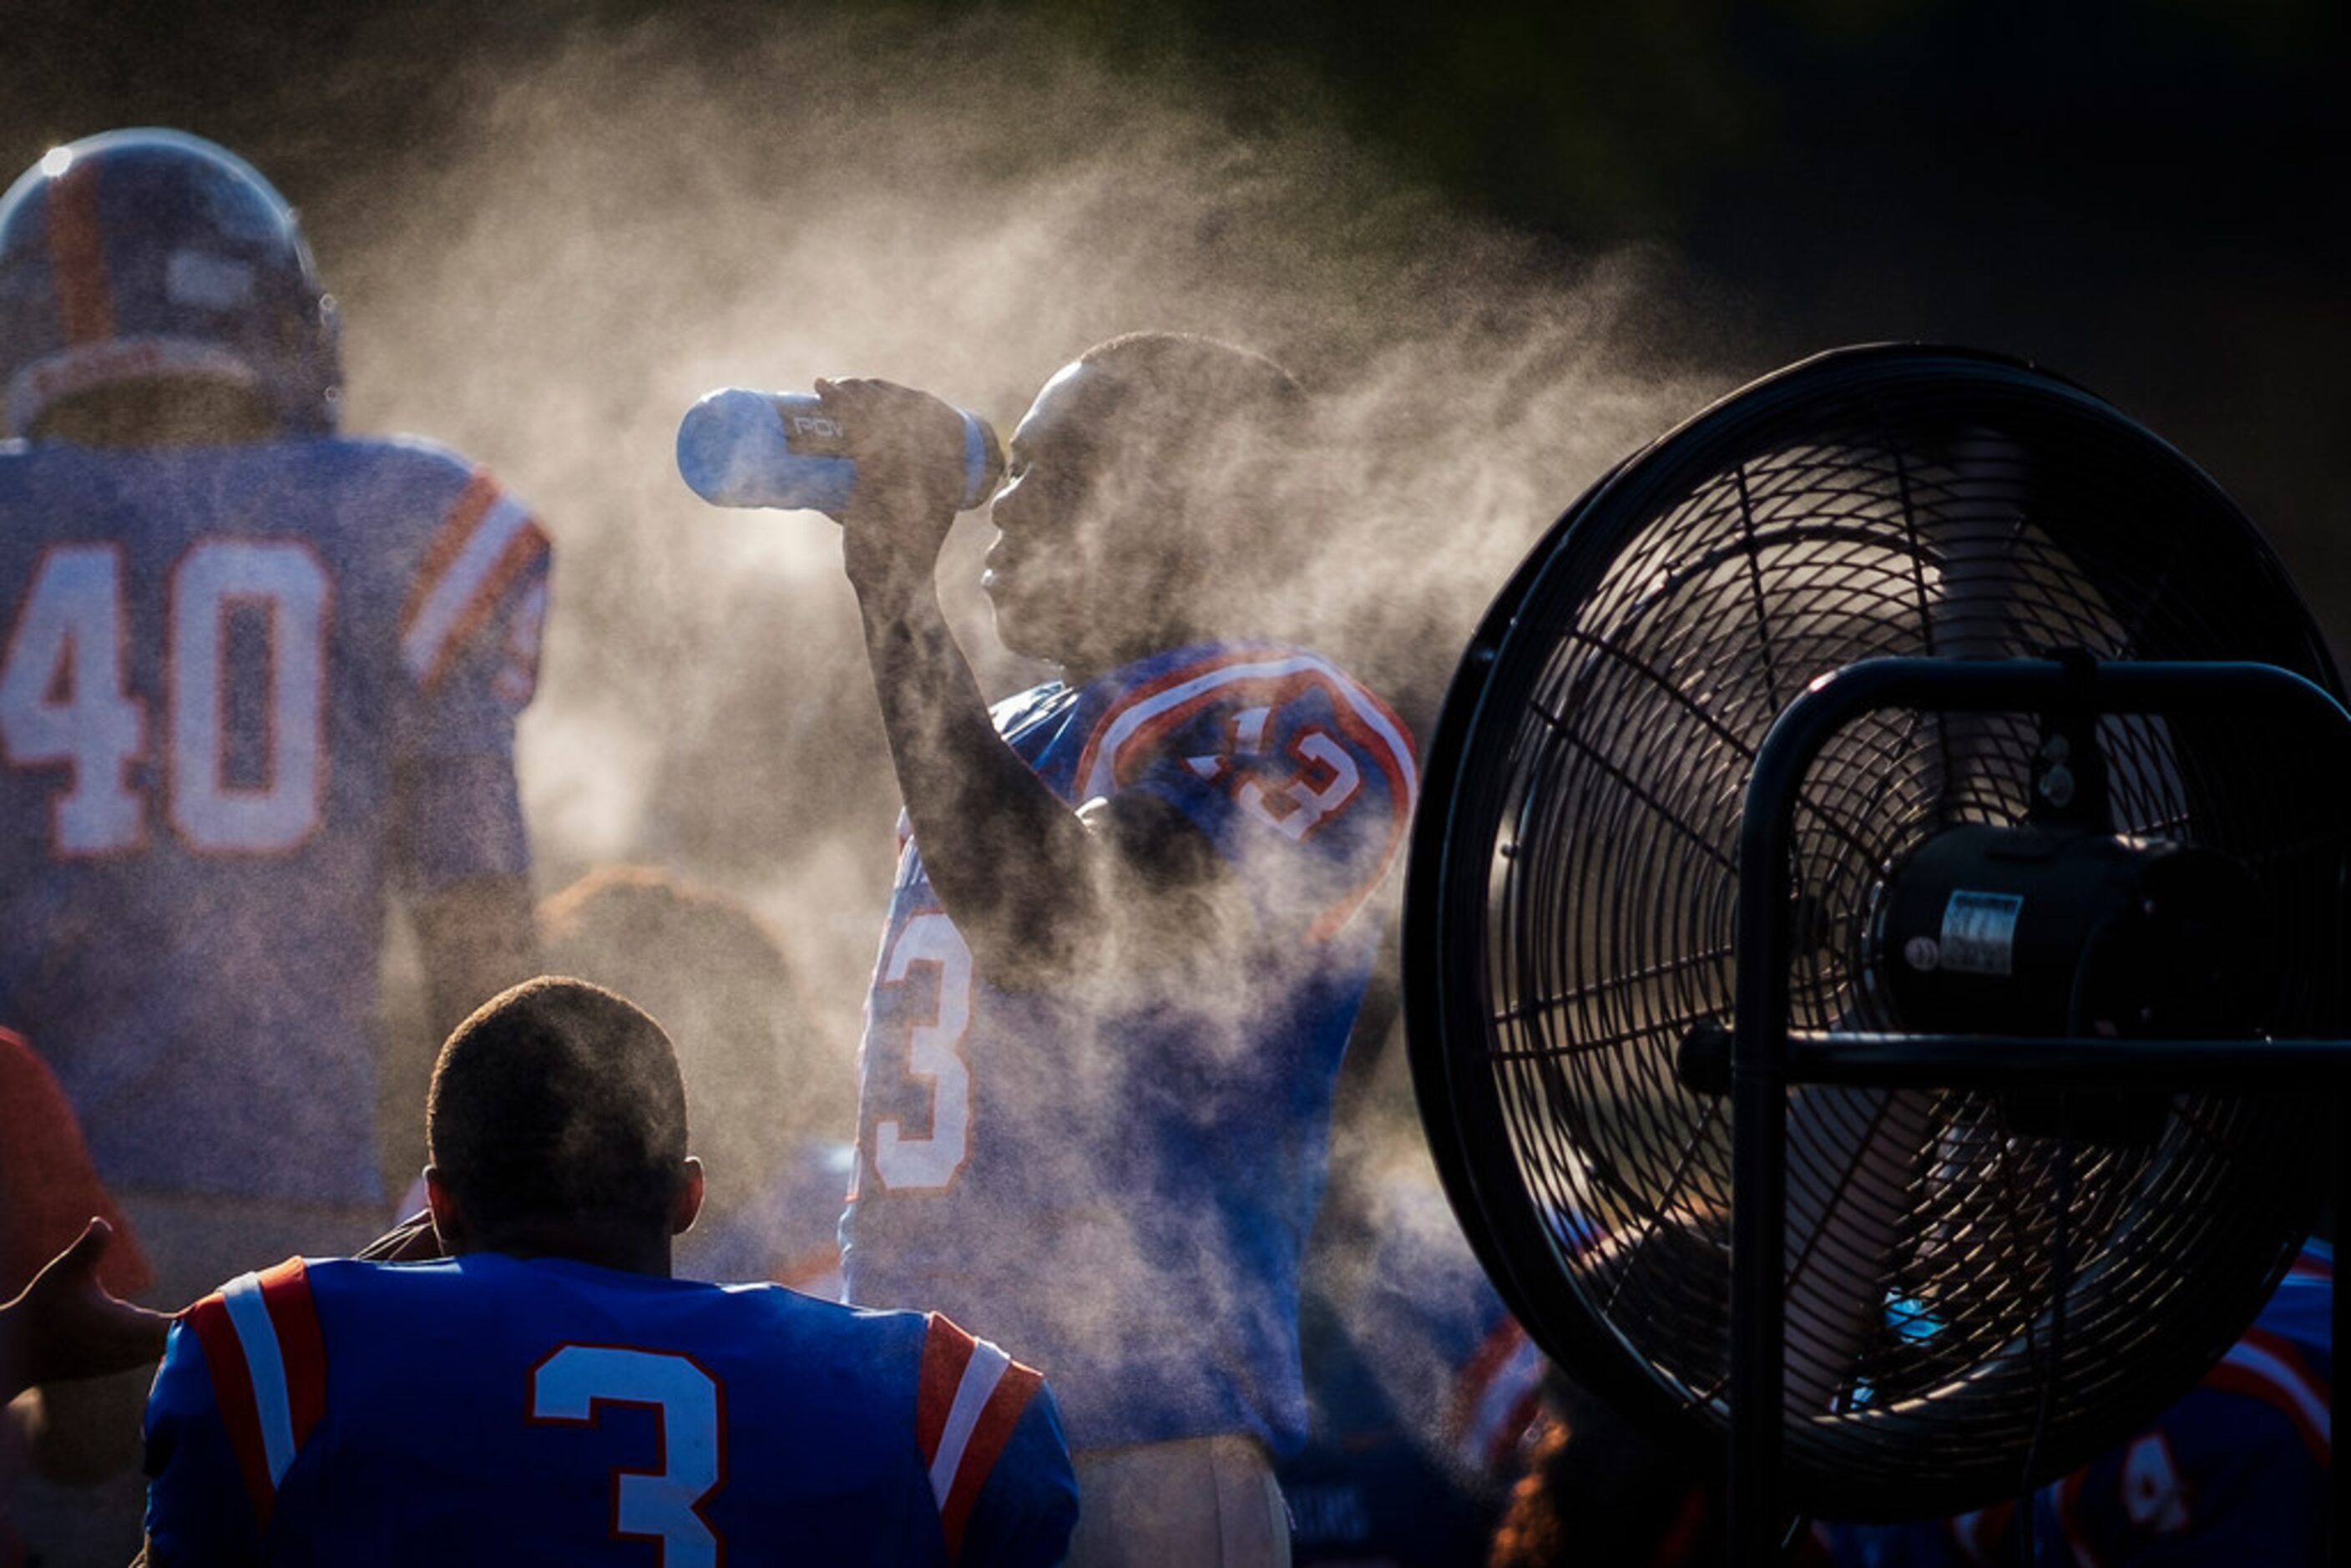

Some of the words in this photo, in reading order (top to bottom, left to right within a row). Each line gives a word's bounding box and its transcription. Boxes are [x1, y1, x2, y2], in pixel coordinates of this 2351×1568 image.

[0, 534, 334, 860] 40
[873, 907, 977, 1197] 3
[524, 1341, 728, 1568] 3
